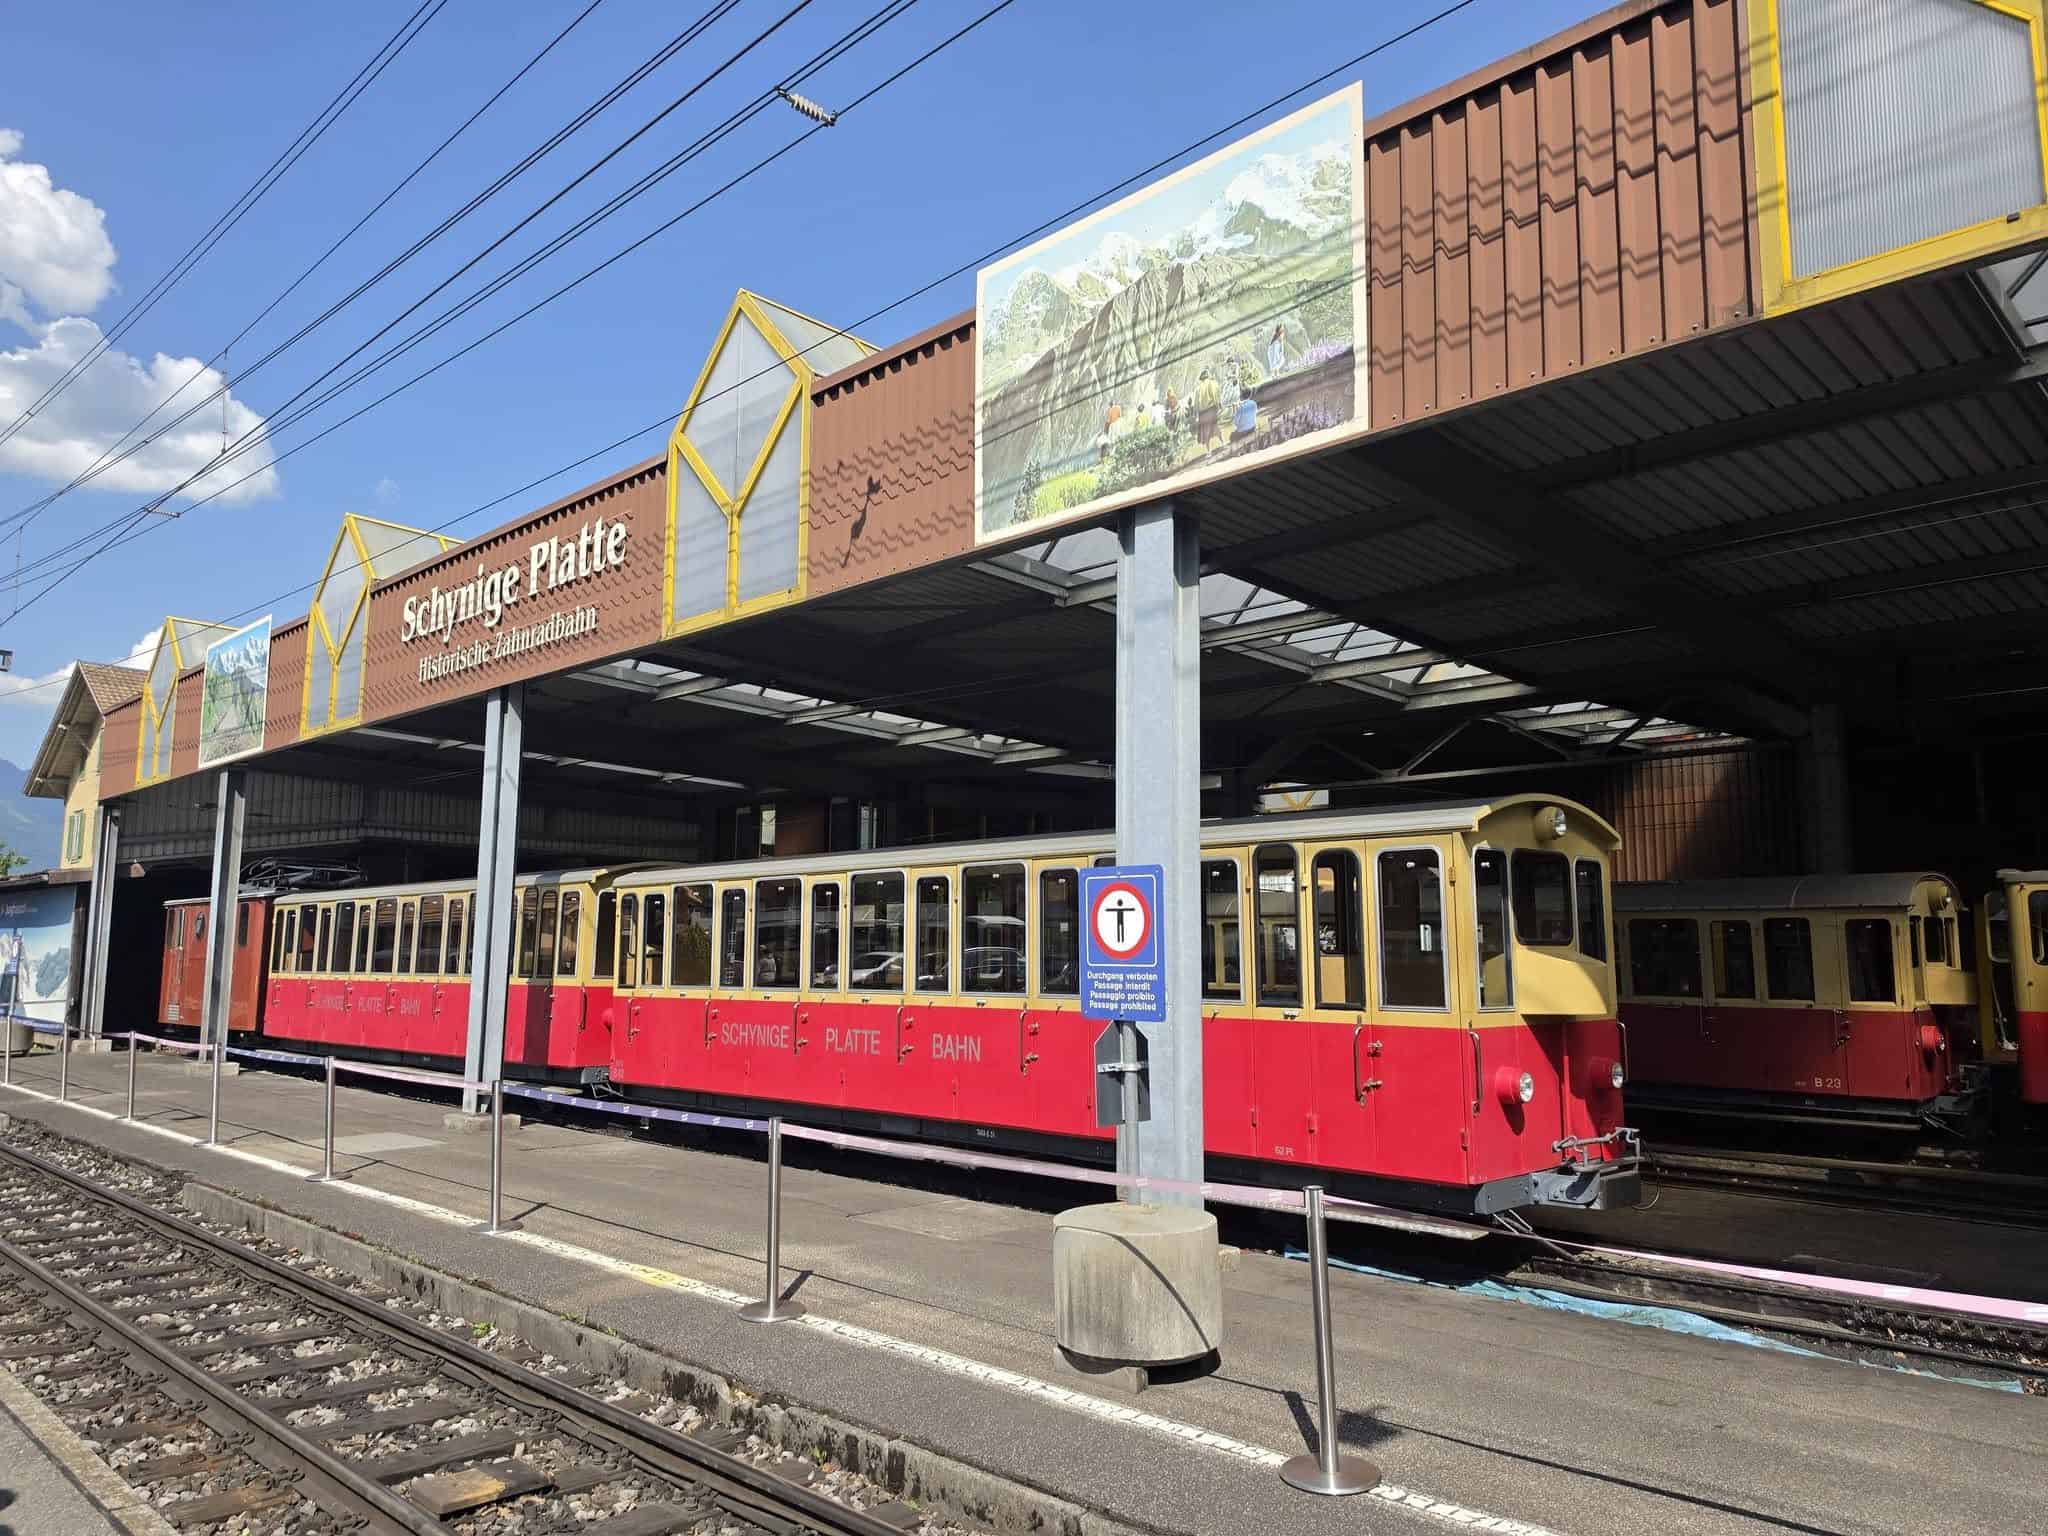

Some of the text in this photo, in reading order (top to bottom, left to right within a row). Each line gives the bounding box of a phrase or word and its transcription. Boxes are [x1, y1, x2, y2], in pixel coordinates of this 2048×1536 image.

[401, 516, 627, 643] Schynige Platte
[419, 606, 597, 682] Historische Zahnradbahn
[1087, 971, 1158, 981] Durchgang verboten
[1094, 981, 1151, 990] Passage interdit
[1090, 991, 1155, 1001] Passaggio proibito
[1089, 1000, 1156, 1011] Passage prohibited
[721, 1023, 982, 1062] SCHYNIGE PLATTE BAHN
